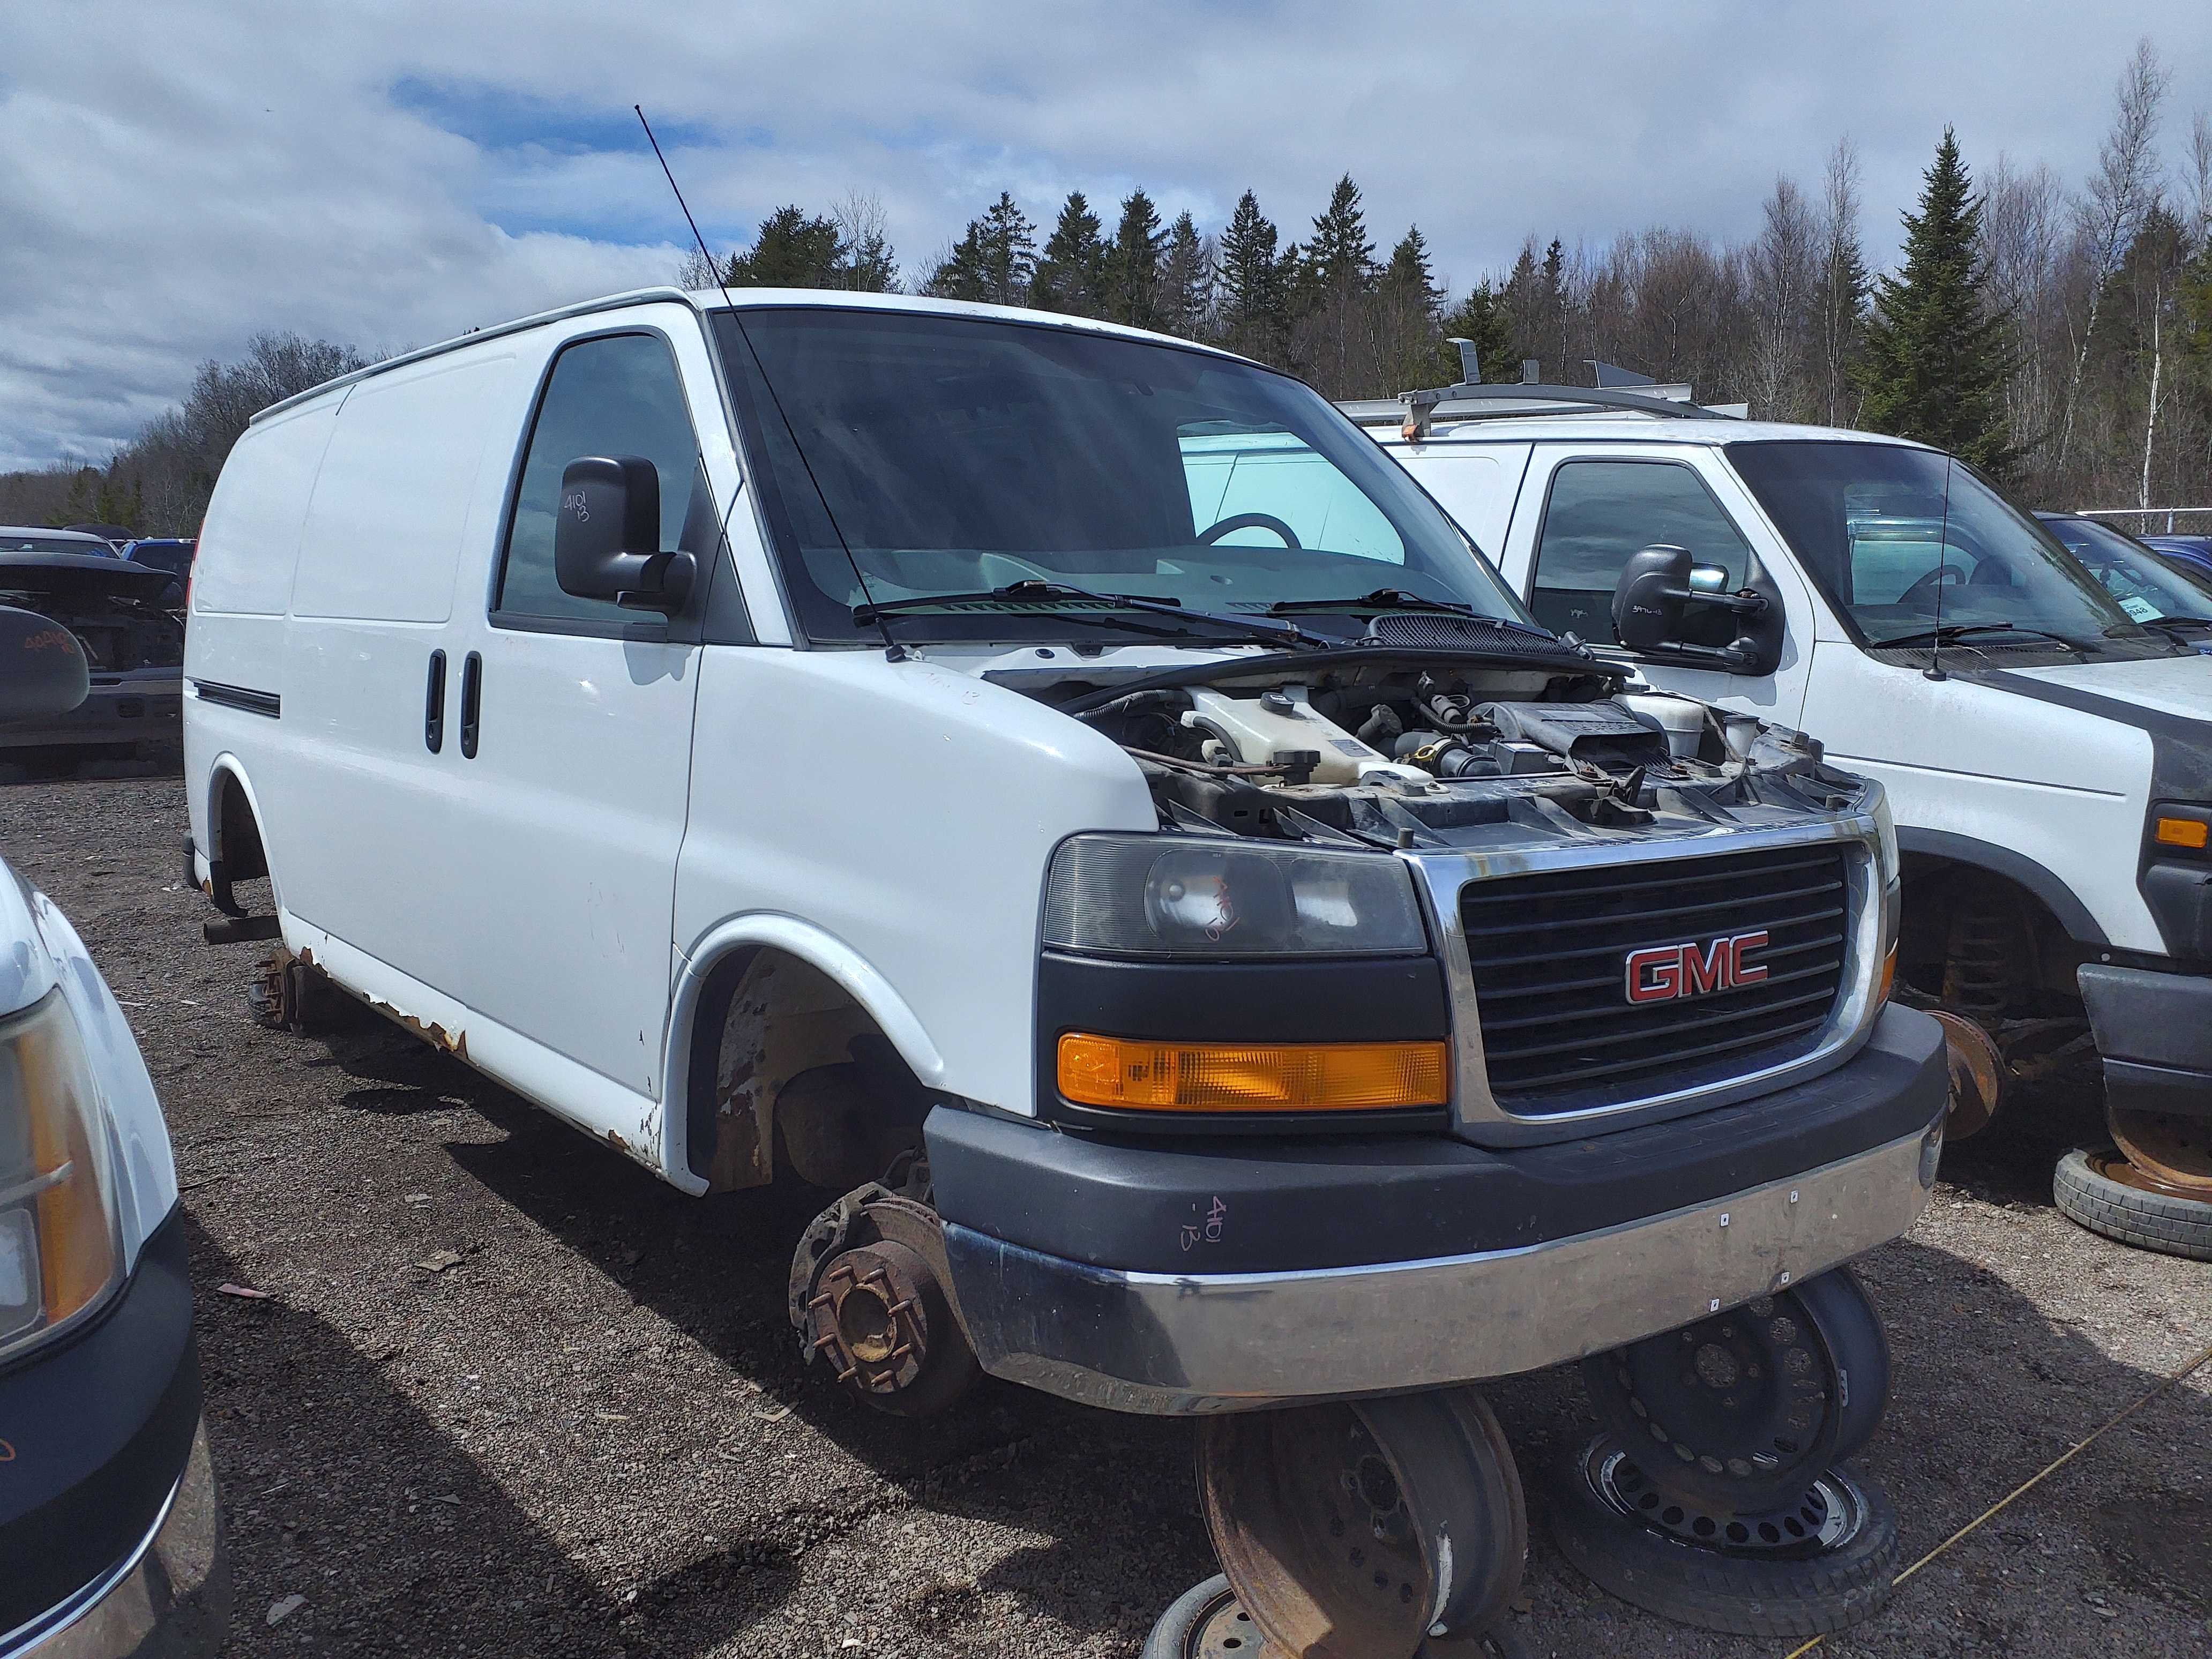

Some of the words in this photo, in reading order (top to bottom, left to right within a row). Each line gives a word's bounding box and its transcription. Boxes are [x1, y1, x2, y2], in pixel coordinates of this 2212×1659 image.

[564, 491, 586, 511] 4101
[577, 505, 590, 522] 13
[1625, 930, 1768, 1005] GMC
[1206, 1195, 1227, 1243] 4101
